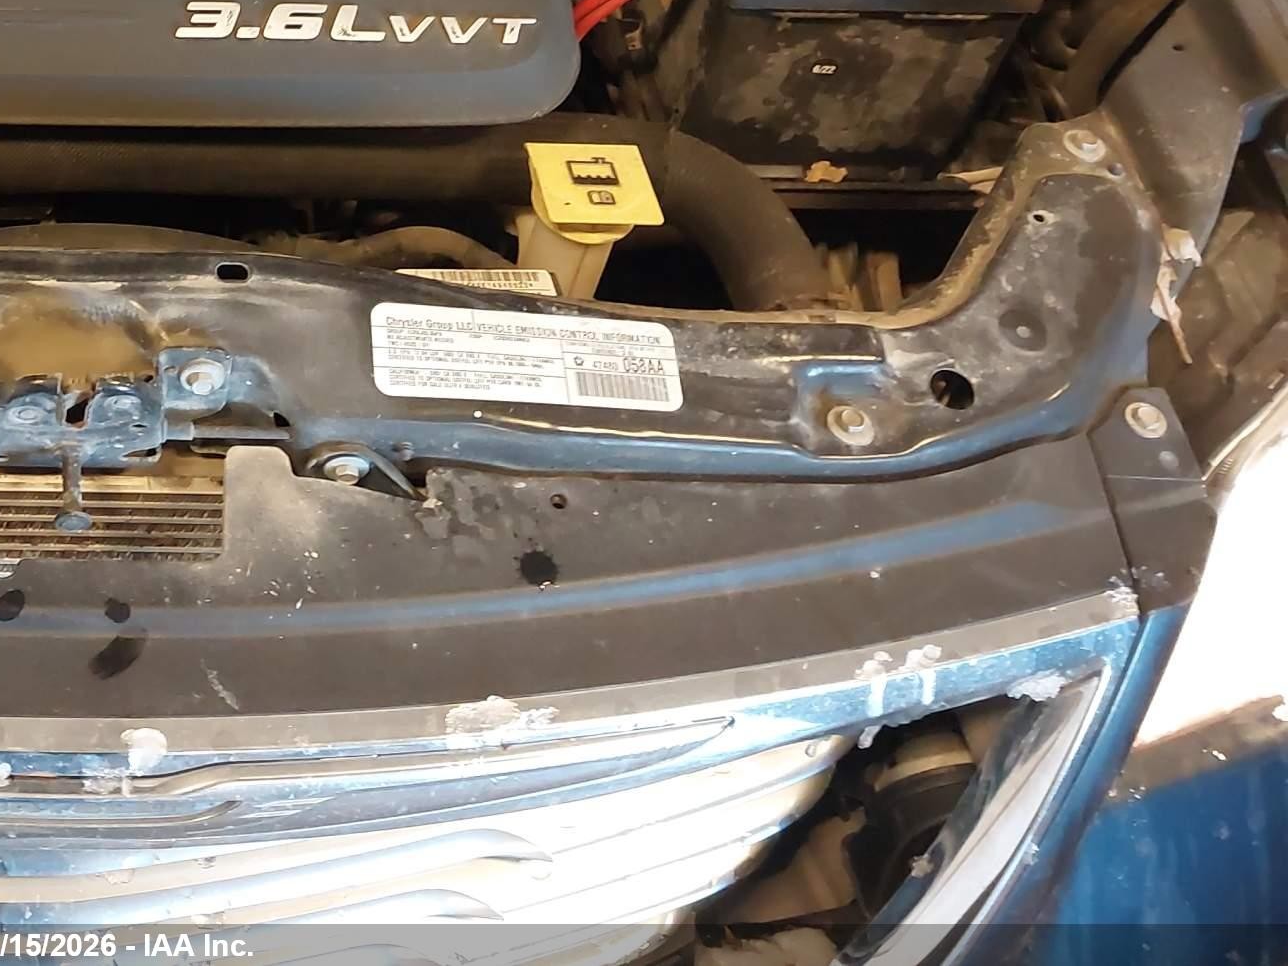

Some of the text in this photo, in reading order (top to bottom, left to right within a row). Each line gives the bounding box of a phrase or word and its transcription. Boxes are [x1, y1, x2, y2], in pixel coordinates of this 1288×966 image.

[176, 1, 537, 44] 3.6L VVT
[386, 316, 423, 328] Chrysler
[426, 319, 454, 331] Group
[560, 330, 600, 340] CONTROL
